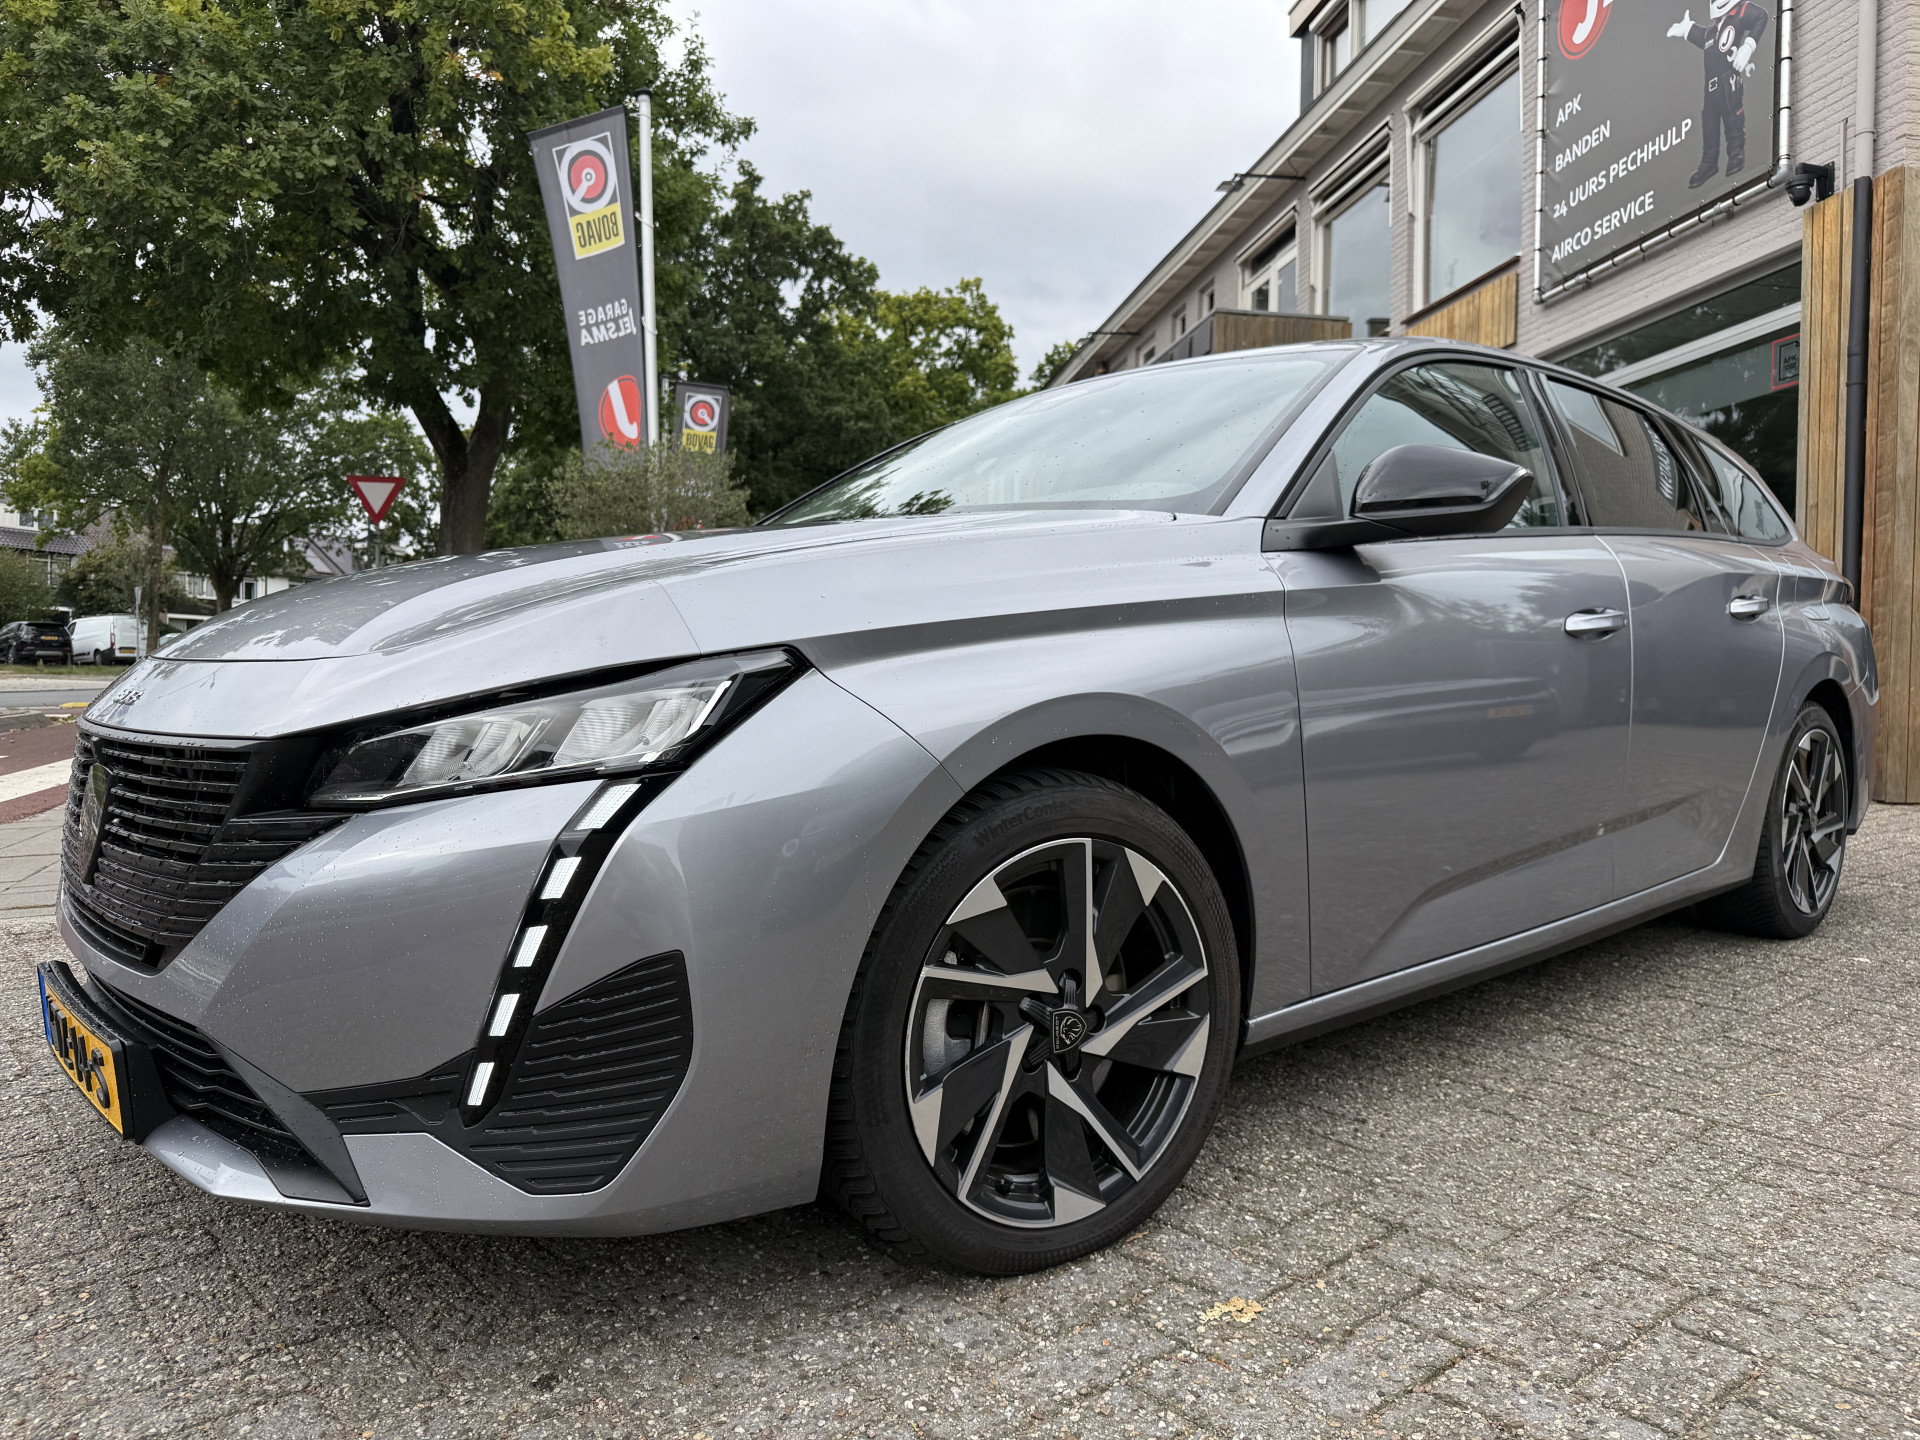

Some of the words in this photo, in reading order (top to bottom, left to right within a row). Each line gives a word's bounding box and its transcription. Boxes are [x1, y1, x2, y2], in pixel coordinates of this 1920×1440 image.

[1556, 93, 1582, 128] APK
[1552, 200, 1569, 219] 24
[1569, 169, 1607, 208] UURS
[1609, 117, 1693, 184] PECHHULP
[1555, 119, 1612, 173] BANDEN
[1551, 226, 1592, 264] AIRCO
[1593, 190, 1655, 240] SERVICE
[686, 432, 714, 449] BOVAG
